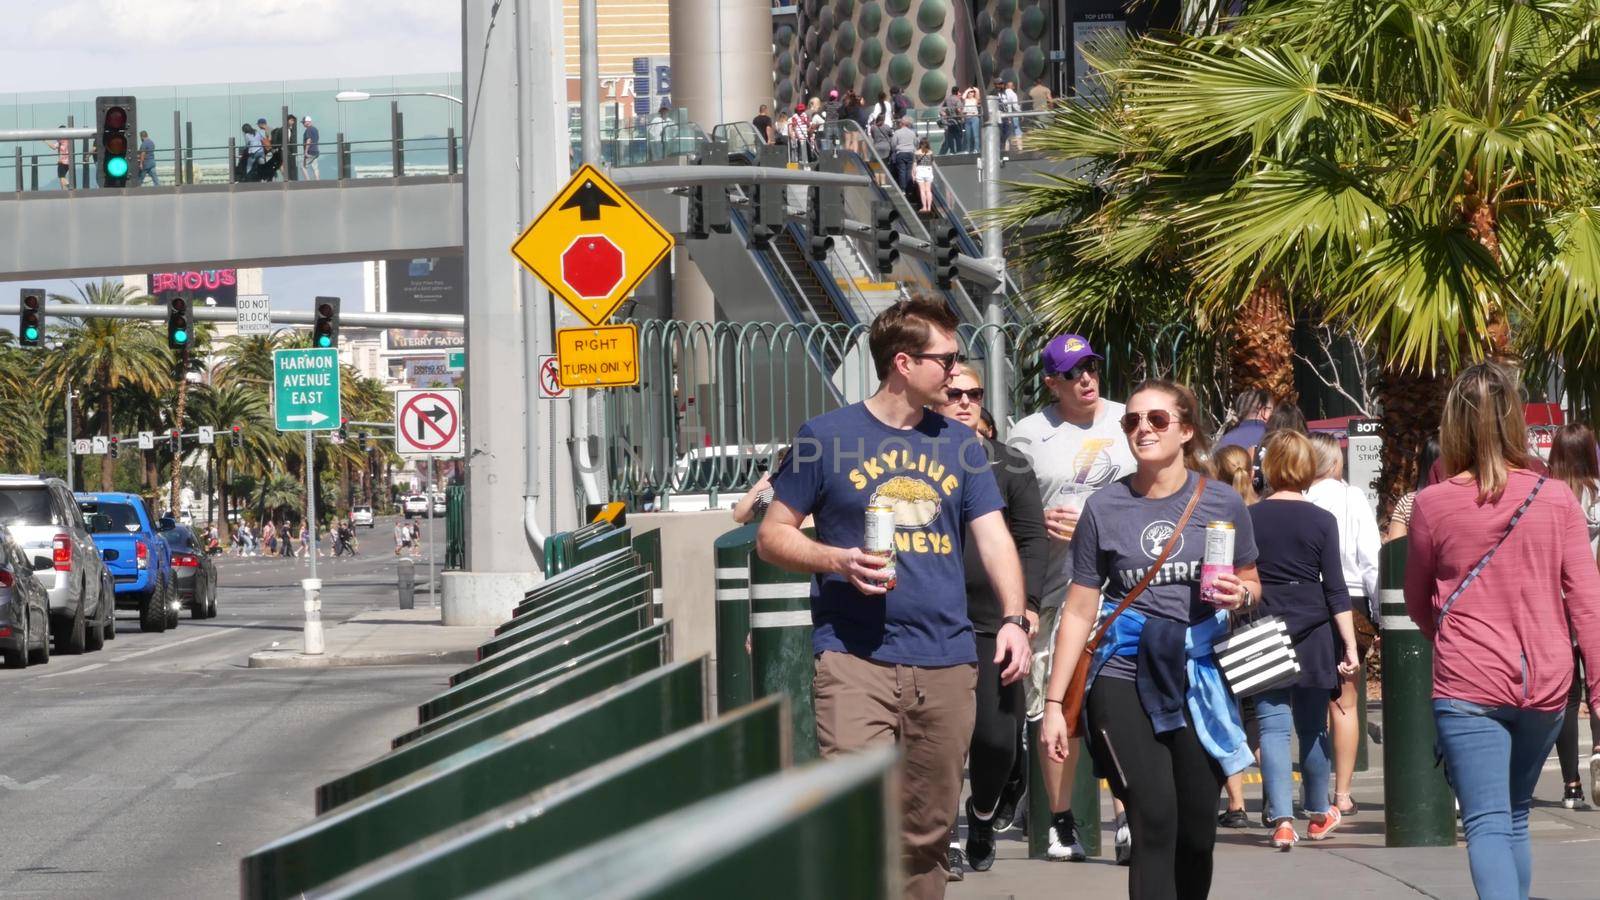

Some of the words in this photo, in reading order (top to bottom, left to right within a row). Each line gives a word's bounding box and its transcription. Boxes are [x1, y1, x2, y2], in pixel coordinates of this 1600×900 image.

[601, 78, 636, 97] TR
[239, 301, 250, 309] DO
[252, 300, 268, 309] NOT
[240, 313, 269, 321] BLOCK
[575, 339, 617, 351] RIGHT
[280, 356, 332, 369] HARMON
[564, 363, 597, 375] TURN
[284, 373, 331, 387] AVENUE
[292, 391, 323, 405] EAST
[1357, 423, 1382, 433] BOT
[849, 450, 960, 497] SKYLINE
[892, 531, 953, 555] NEYS
